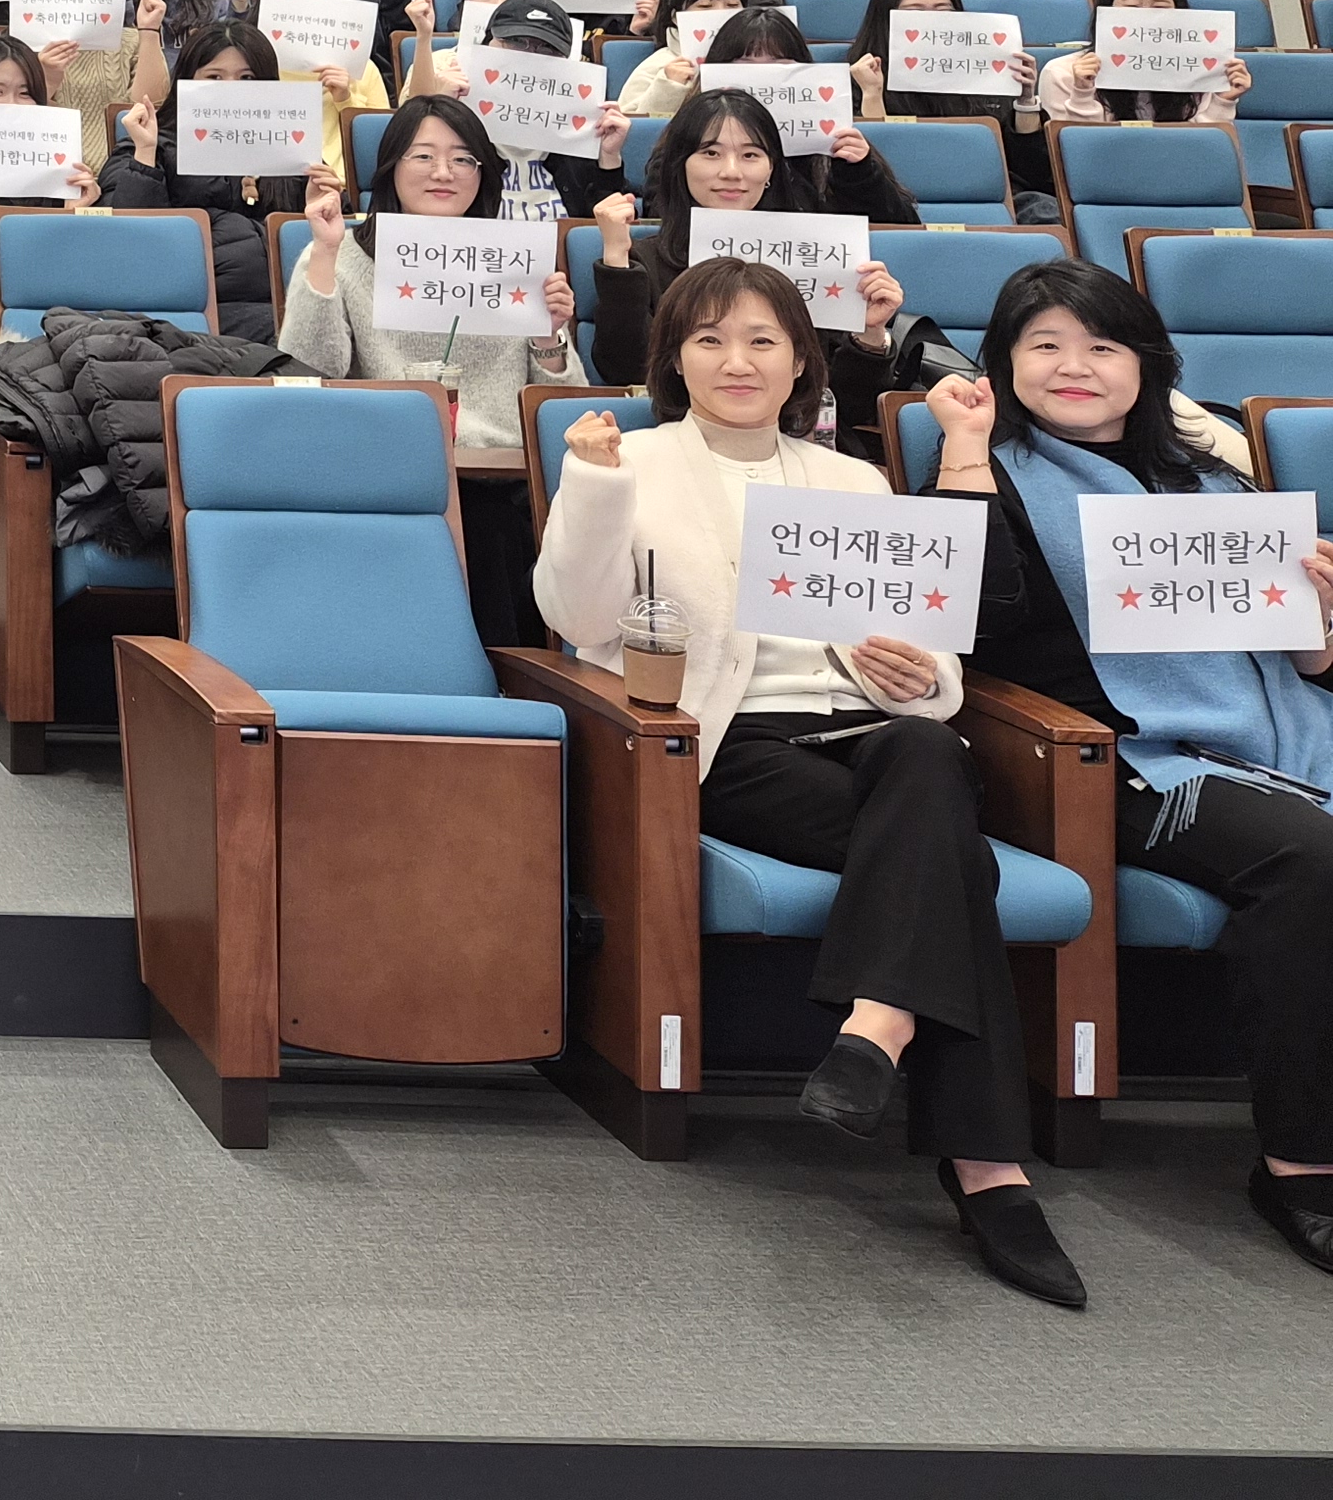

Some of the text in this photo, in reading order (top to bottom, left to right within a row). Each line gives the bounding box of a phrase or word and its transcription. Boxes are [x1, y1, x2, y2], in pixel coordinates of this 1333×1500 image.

[35, 11, 98, 25] 축하합니다
[284, 31, 349, 49] 축하합니다
[920, 28, 991, 47] 사랑해요
[1128, 26, 1202, 45] 사랑해요
[920, 56, 990, 75] 강원지부
[1127, 53, 1201, 72] 강원지부
[500, 71, 575, 98] 사랑해요
[192, 108, 307, 120] 강원지부언어재활 컨벤션
[494, 102, 570, 131] 강원지부
[40, 132, 68, 143] 컨벤션
[209, 128, 290, 146] 축하합니다
[779, 119, 817, 137] 지부
[396, 241, 536, 276] 언어재활사
[711, 237, 851, 269] 언어재활사
[421, 280, 503, 310] 화이팅
[769, 521, 959, 570] 언어재활사
[1110, 528, 1292, 568] 언어재활사
[801, 572, 915, 613] 화이팅
[1148, 578, 1252, 614] 화이팅
